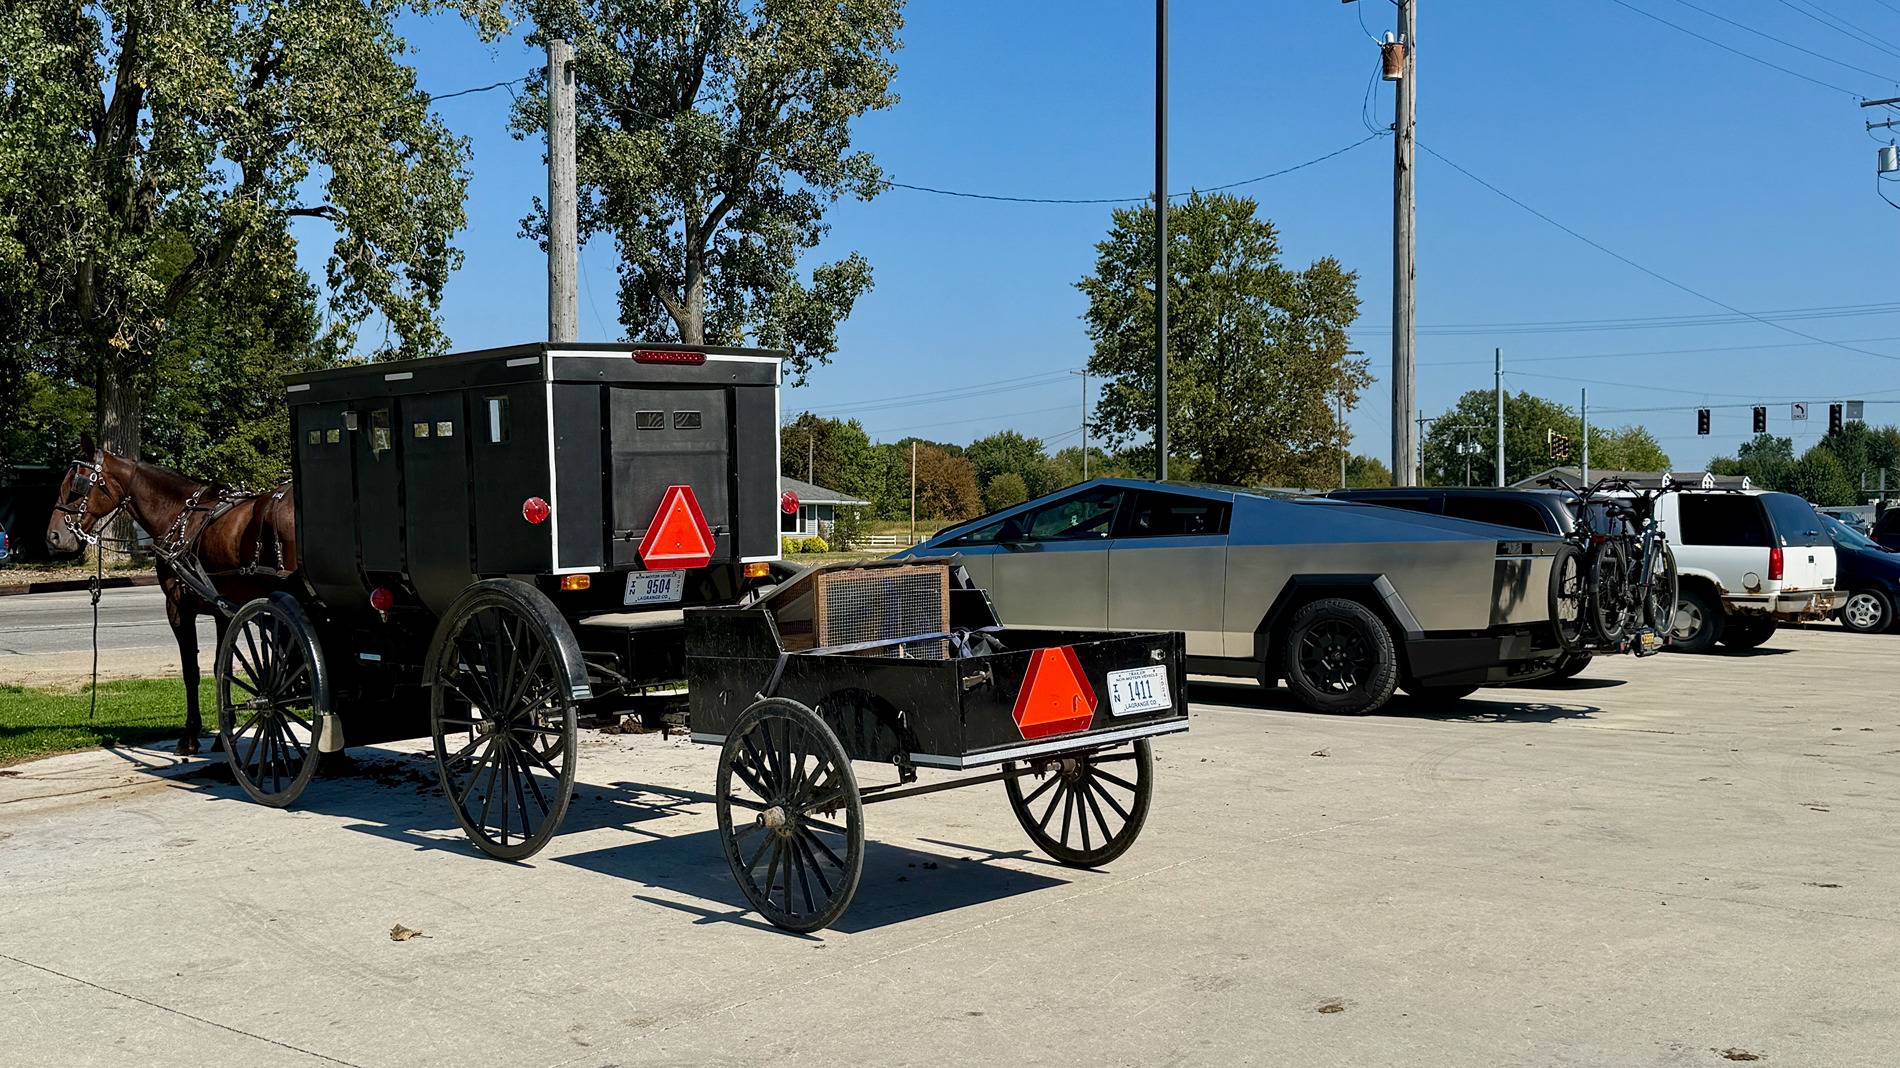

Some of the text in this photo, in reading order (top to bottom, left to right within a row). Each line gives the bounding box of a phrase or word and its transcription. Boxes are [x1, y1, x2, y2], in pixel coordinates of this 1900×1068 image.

[647, 578, 671, 594] 9504
[1127, 679, 1153, 701] 1411
[1126, 701, 1150, 709] LAGRANGE
